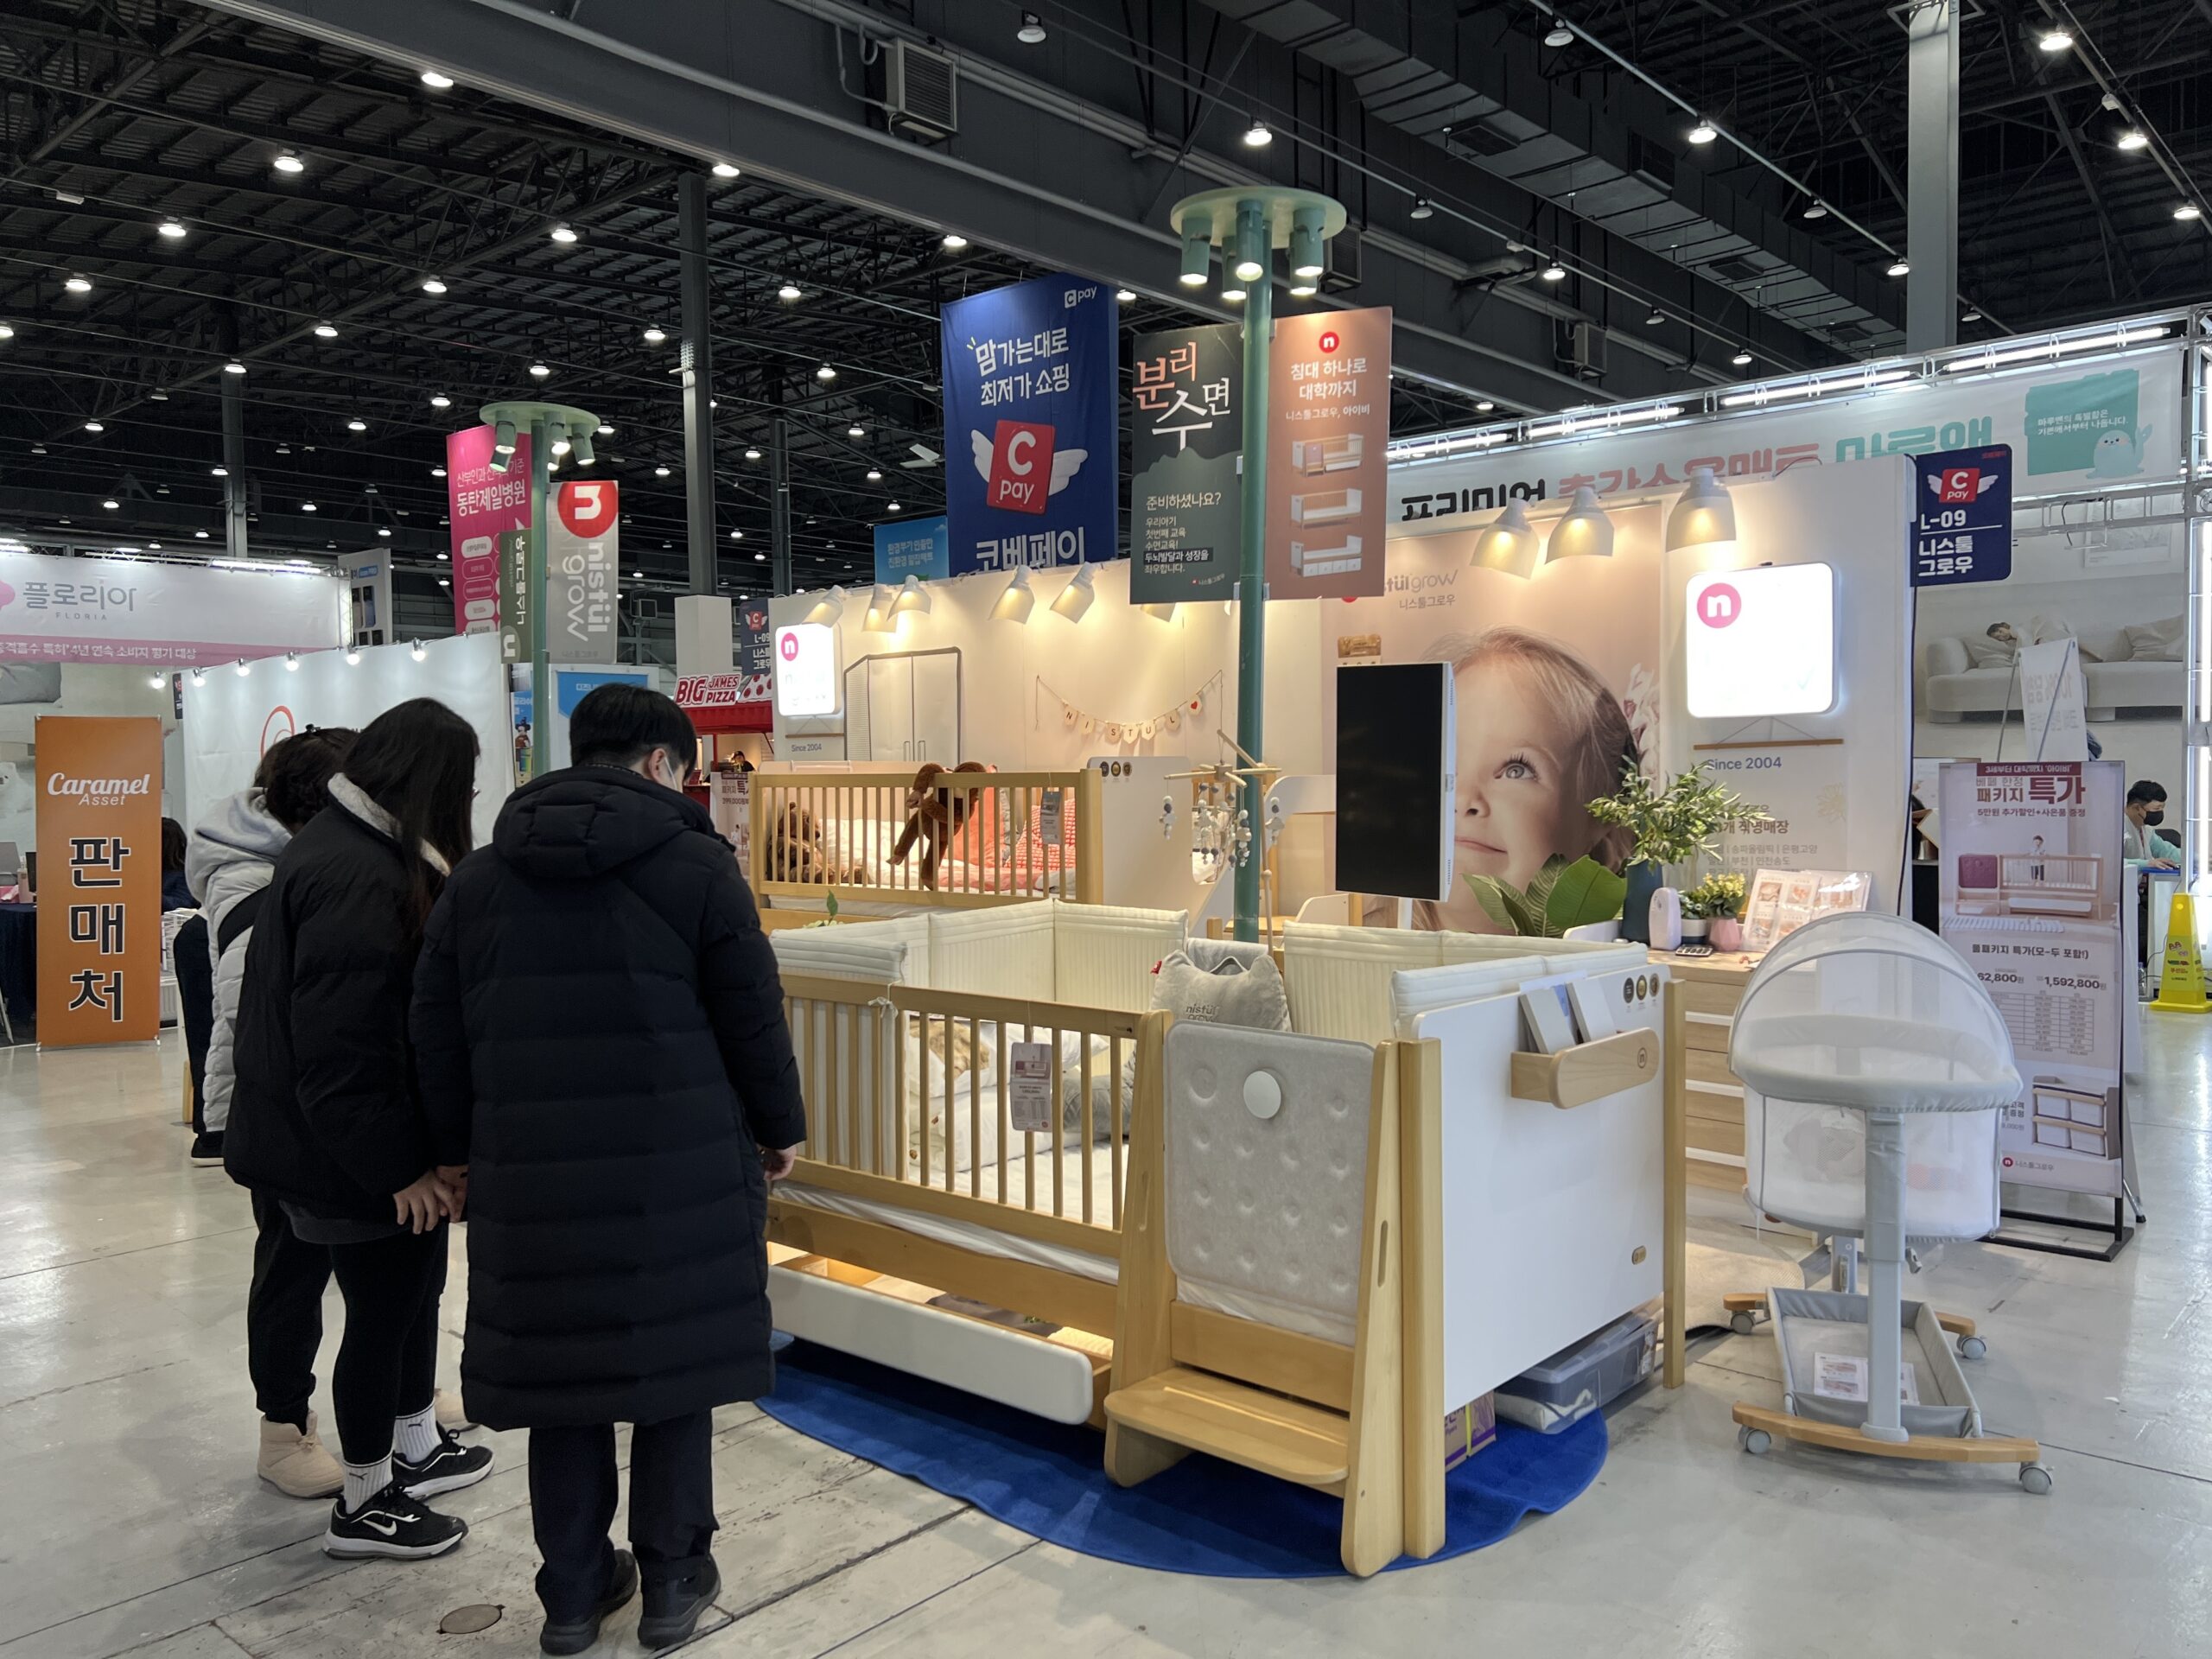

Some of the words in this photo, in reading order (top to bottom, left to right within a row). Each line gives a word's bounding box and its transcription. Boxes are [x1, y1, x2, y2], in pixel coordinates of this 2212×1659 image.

[1077, 286, 1097, 302] pay
[1323, 335, 1335, 348] n
[976, 327, 1069, 378] 맘가는대로
[1133, 342, 1197, 410] 분리
[1291, 361, 1319, 380] 침대
[1323, 358, 1367, 377] 하나로
[981, 372, 1032, 406] 최저가
[1035, 363, 1070, 395] 쇼핑
[1299, 378, 1357, 401] 대학까지
[1152, 377, 1230, 451] 수면
[1286, 407, 1341, 421] 니스툴그로우,
[1343, 404, 1370, 416] 아이비
[2037, 422, 2088, 435] 기본에서부터
[1007, 430, 1036, 475] C
[456, 467, 486, 488] 산부인과
[1950, 471, 1968, 490] C
[456, 479, 525, 517] 동탄제일병원
[999, 480, 1034, 505] pay
[1146, 492, 1221, 511] 준비하셨나요?
[1947, 490, 1969, 500] pay
[1145, 516, 1177, 527] 우리아기
[1920, 509, 1967, 530] L-09
[1145, 528, 1169, 540] 첫번째
[1170, 526, 1186, 537] 교육
[976, 526, 1085, 572] 코베페이
[1145, 551, 1185, 563] 두뇌발달과
[1185, 549, 1210, 561] 성장을
[1918, 535, 1974, 556] 니스툴
[1918, 556, 1974, 577] 그로우
[515, 535, 526, 625] 니스툴그로우
[588, 542, 612, 632] nistül
[23, 582, 137, 612] 플로리아
[562, 554, 589, 642] grow
[1400, 594, 1456, 610] 니스툴그로우
[1707, 594, 1732, 618] n
[55, 612, 107, 620] FLORIA
[92, 645, 113, 657] 연속
[175, 648, 196, 660] 대상
[676, 677, 708, 705] BIG
[709, 675, 740, 689] JAMES
[706, 690, 735, 703] PIZZA
[807, 743, 822, 752] 2004
[1707, 758, 1742, 771] Since
[1745, 756, 1783, 770] 2004
[48, 772, 150, 796] Caramel
[1977, 787, 2024, 803] 패키지
[2028, 776, 2086, 804] 특가
[2002, 777, 2023, 787] 한정
[79, 793, 127, 805] Asset
[1978, 808, 2000, 817] 5만원
[2069, 809, 2086, 817] 증정
[1731, 844, 1775, 855] 송파올림픽
[1782, 843, 1818, 855] 은평고양
[68, 836, 130, 1023] 판매처
